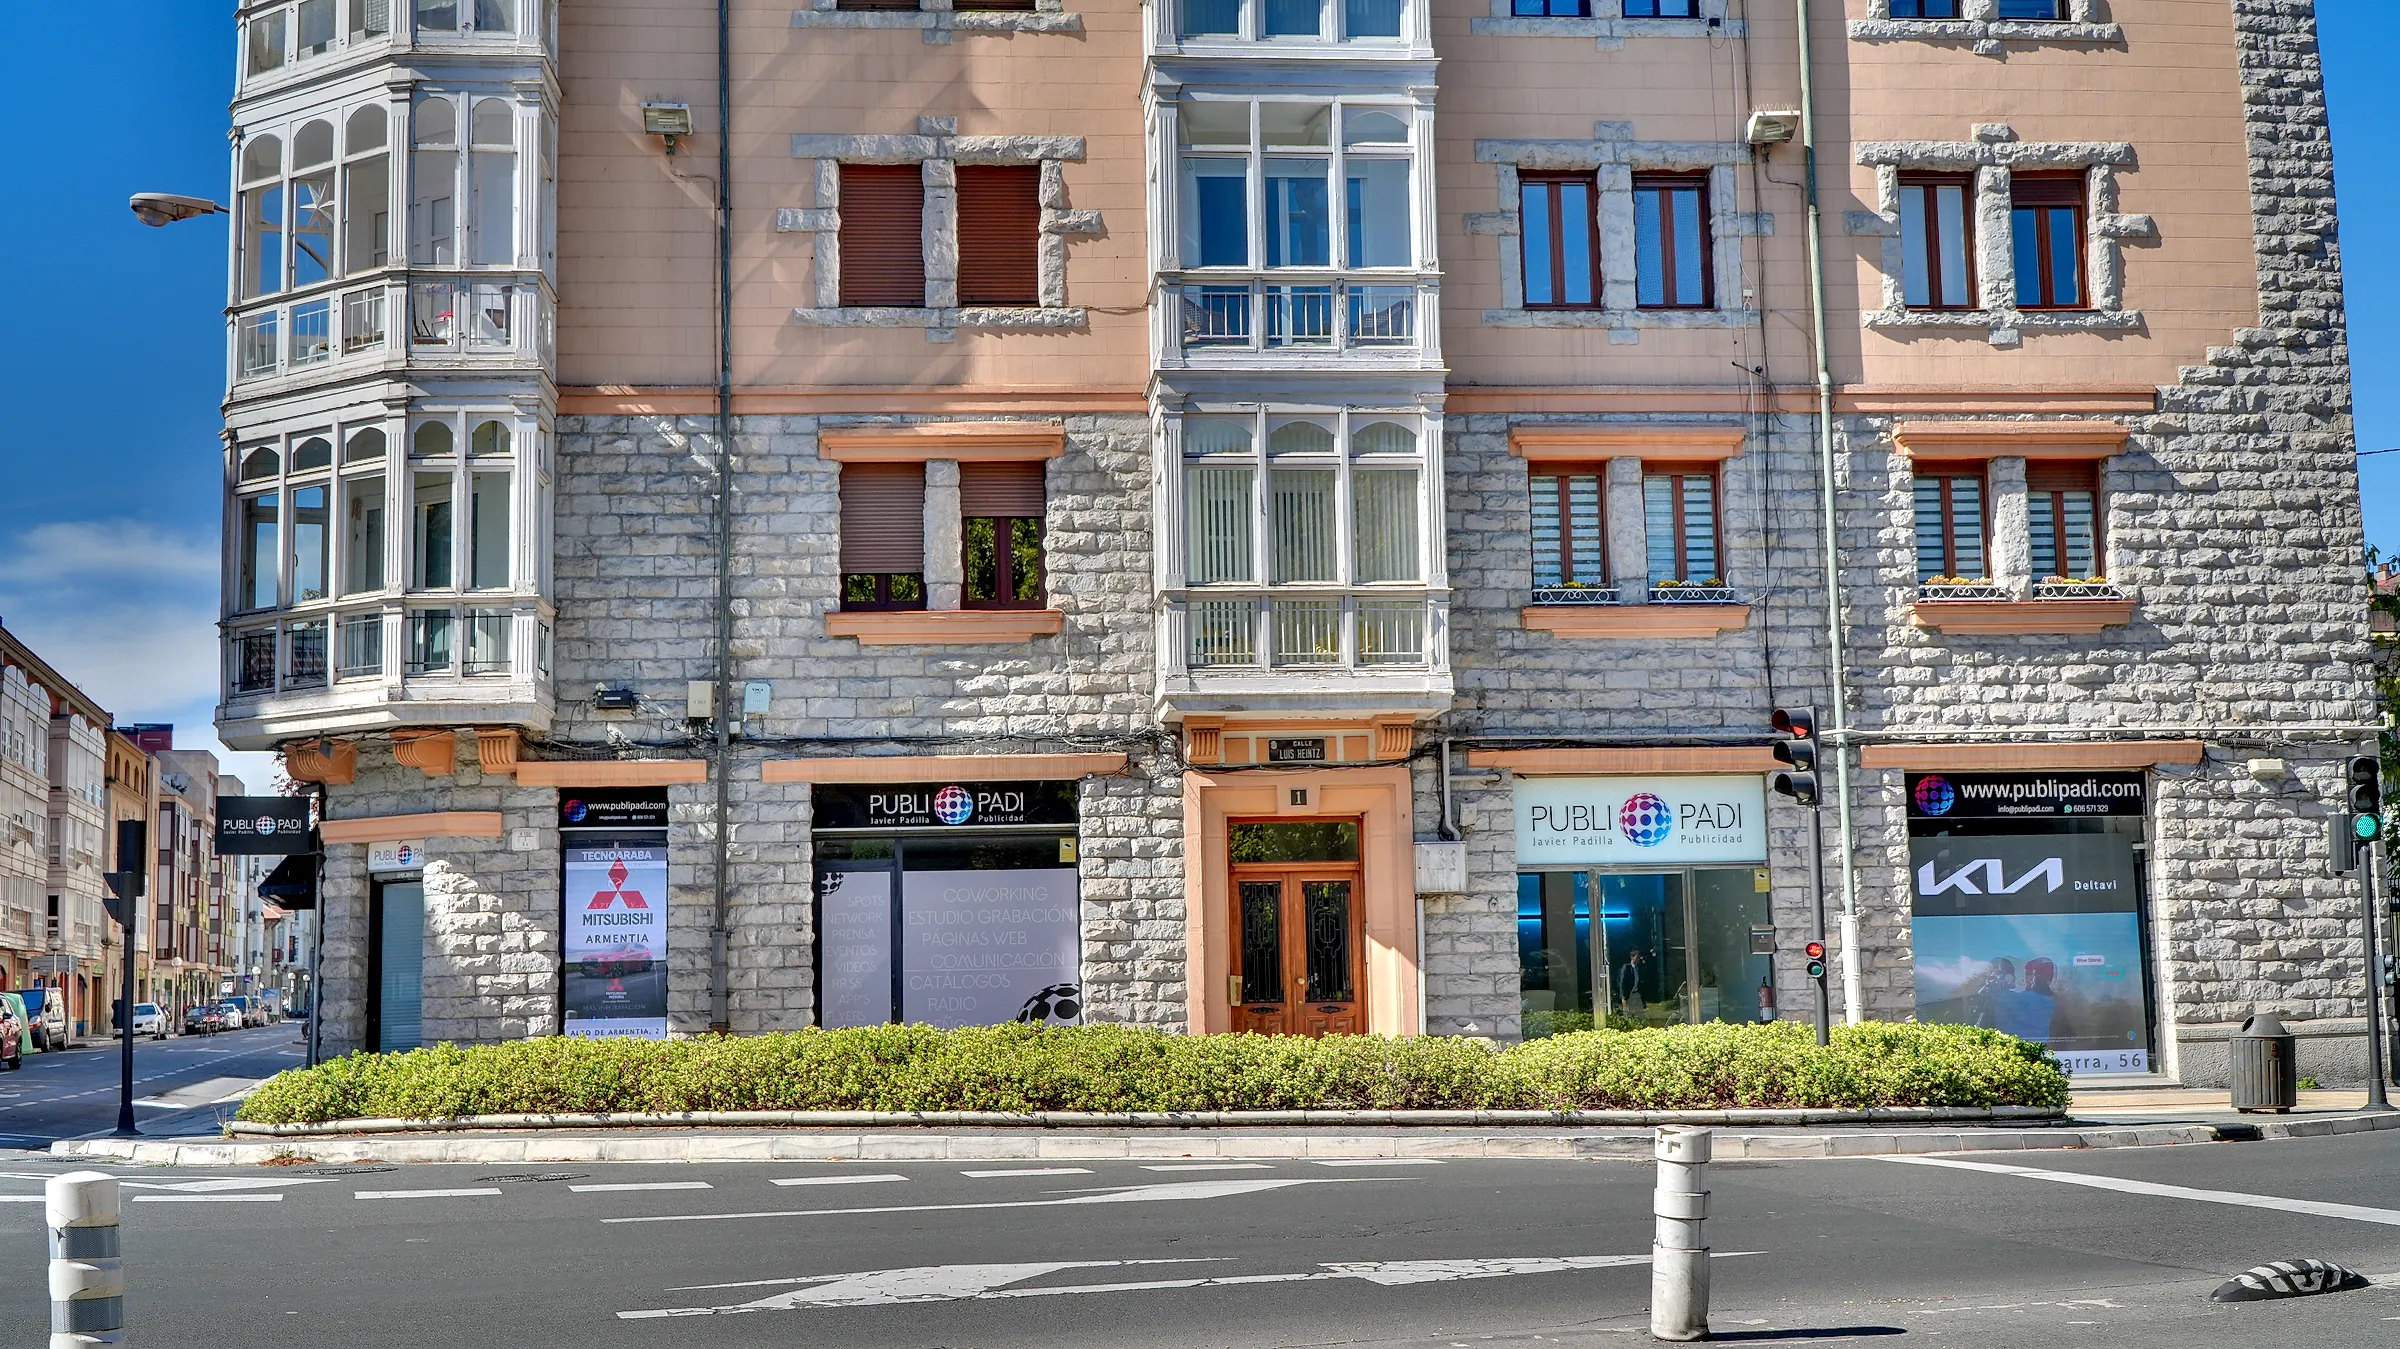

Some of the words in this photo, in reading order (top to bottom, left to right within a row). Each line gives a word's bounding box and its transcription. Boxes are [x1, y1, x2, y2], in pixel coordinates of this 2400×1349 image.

[1280, 749, 1295, 759] LUIS
[1297, 748, 1320, 758] HEINTZ
[1961, 779, 2141, 801] www.publipadi.com
[870, 794, 928, 814] PUBLI
[978, 792, 1023, 812] PADI
[1295, 791, 1301, 804] 1
[588, 801, 666, 812] www.publipadi.com
[900, 816, 929, 824] Padilla
[978, 814, 1023, 822] Publicidad
[1531, 805, 1611, 831] PUBLI
[1680, 803, 1741, 829] PADI
[223, 820, 254, 830] PUBLI
[278, 819, 301, 829] PADI
[1533, 838, 1565, 846] Javier
[1573, 837, 1613, 845] Padilla
[1681, 834, 1742, 843] Publicidad
[374, 850, 396, 861] PUBLI
[582, 851, 652, 861] TECNOARABA
[2074, 880, 2116, 891] Deltavi
[847, 895, 885, 907] SPOTS
[943, 887, 1048, 902] COWORKING
[583, 913, 653, 926] MITSUBISHI
[825, 911, 883, 925] NETWORK
[908, 910, 974, 925] ESTUDIO
[978, 904, 1073, 924] GRABACIÓN
[586, 934, 649, 943] ARMENTIA
[833, 929, 875, 940] PRENSA
[922, 928, 989, 946] PÁGINAS
[993, 931, 1027, 945] WEB
[825, 944, 877, 957] EVENTOS
[930, 948, 1066, 969] COMUNICACIÓN
[910, 971, 1010, 990] CATÁLOGOS
[928, 997, 977, 1011] RADIO
[2058, 1057, 2108, 1070] arra,
[2119, 1053, 2140, 1068] 56
